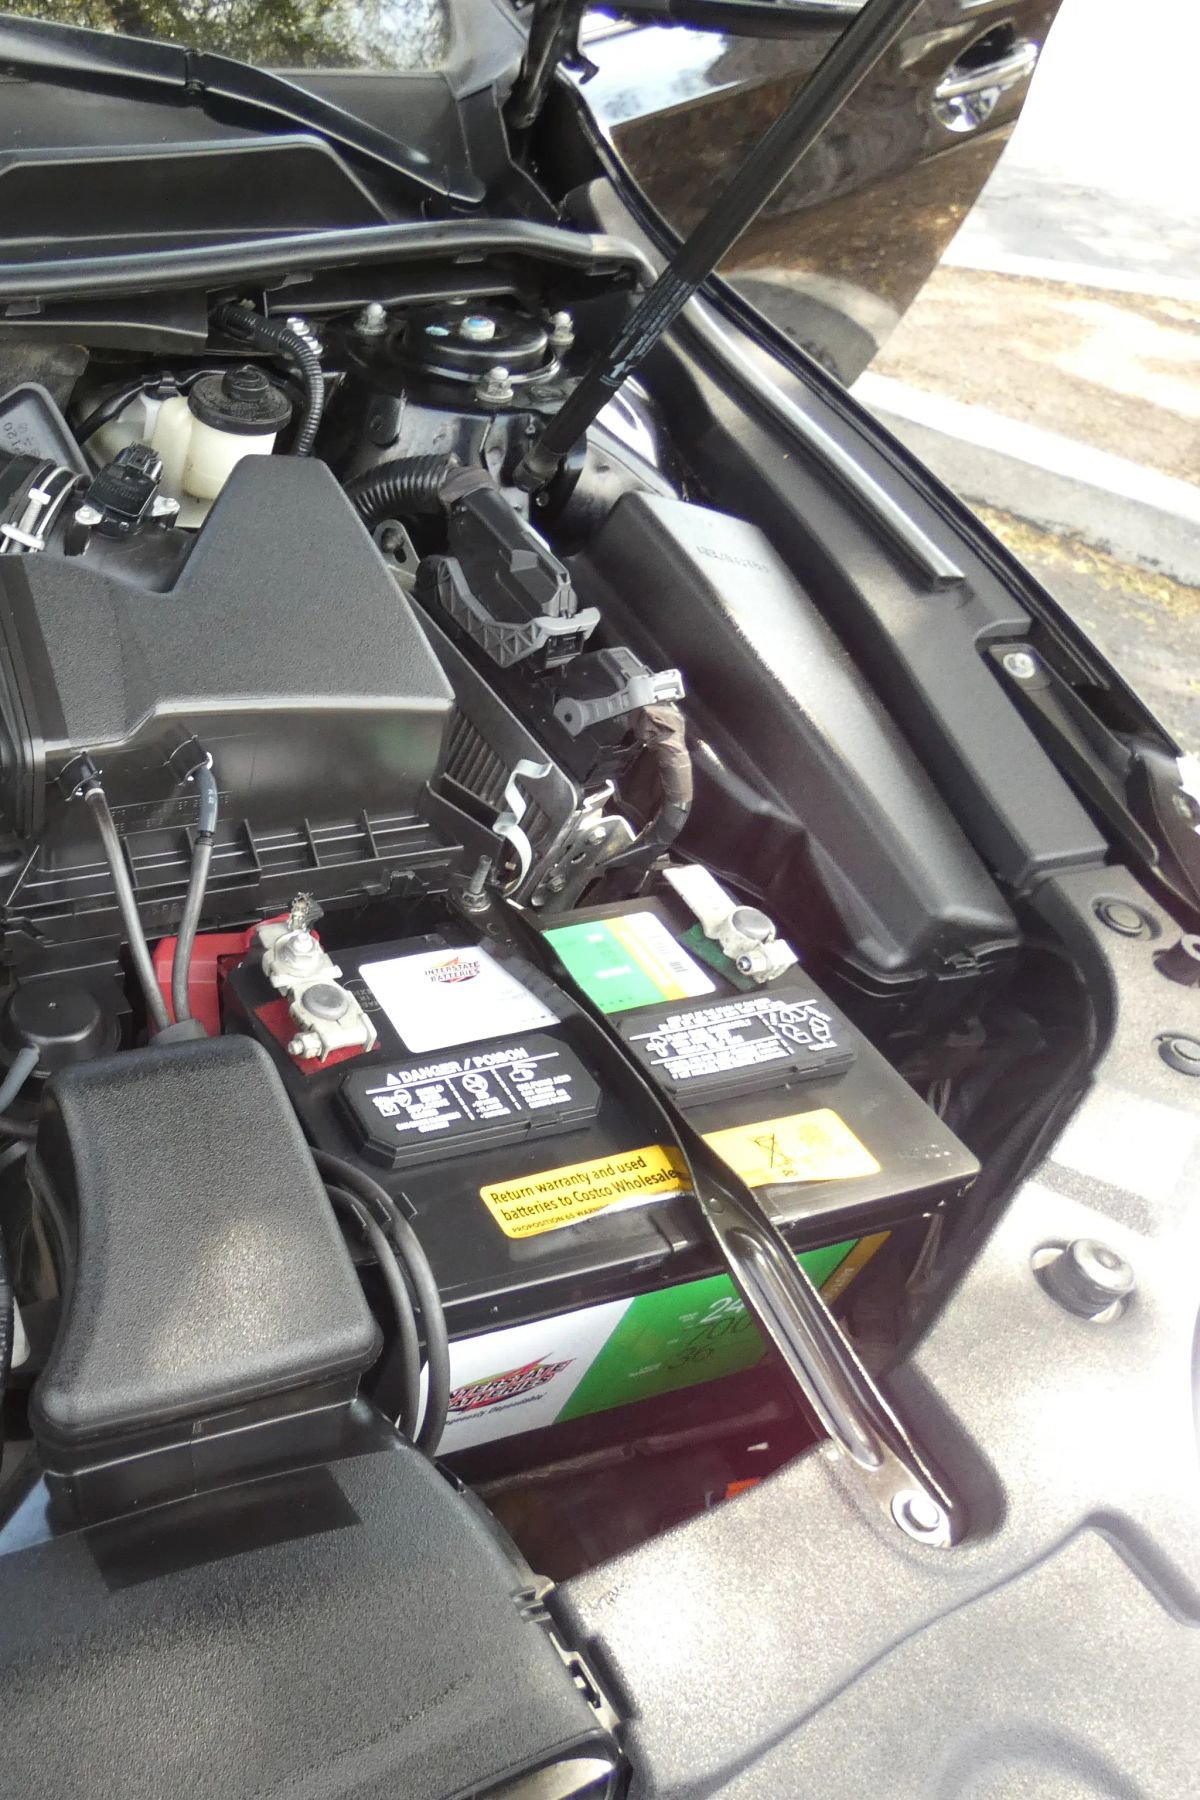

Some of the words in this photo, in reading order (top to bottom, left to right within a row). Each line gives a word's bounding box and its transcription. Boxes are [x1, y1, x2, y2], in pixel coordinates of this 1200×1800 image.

[424, 960, 481, 977] INTERSTATE
[430, 968, 481, 983] BATTERIES
[398, 1060, 462, 1083] DANGER
[473, 1047, 529, 1069] POISON
[490, 1186, 535, 1205] Return
[536, 1172, 592, 1194] warranty
[593, 1164, 616, 1180] and
[617, 1155, 647, 1173] used
[501, 1198, 559, 1222] batteries
[560, 1194, 573, 1207] to
[573, 1185, 612, 1203] Costco
[612, 1167, 678, 1194] Wholesale
[511, 1213, 565, 1233] PROPOSITION
[448, 1376, 551, 1409] ATTERIES
[449, 1361, 569, 1400] NTERSTATE
